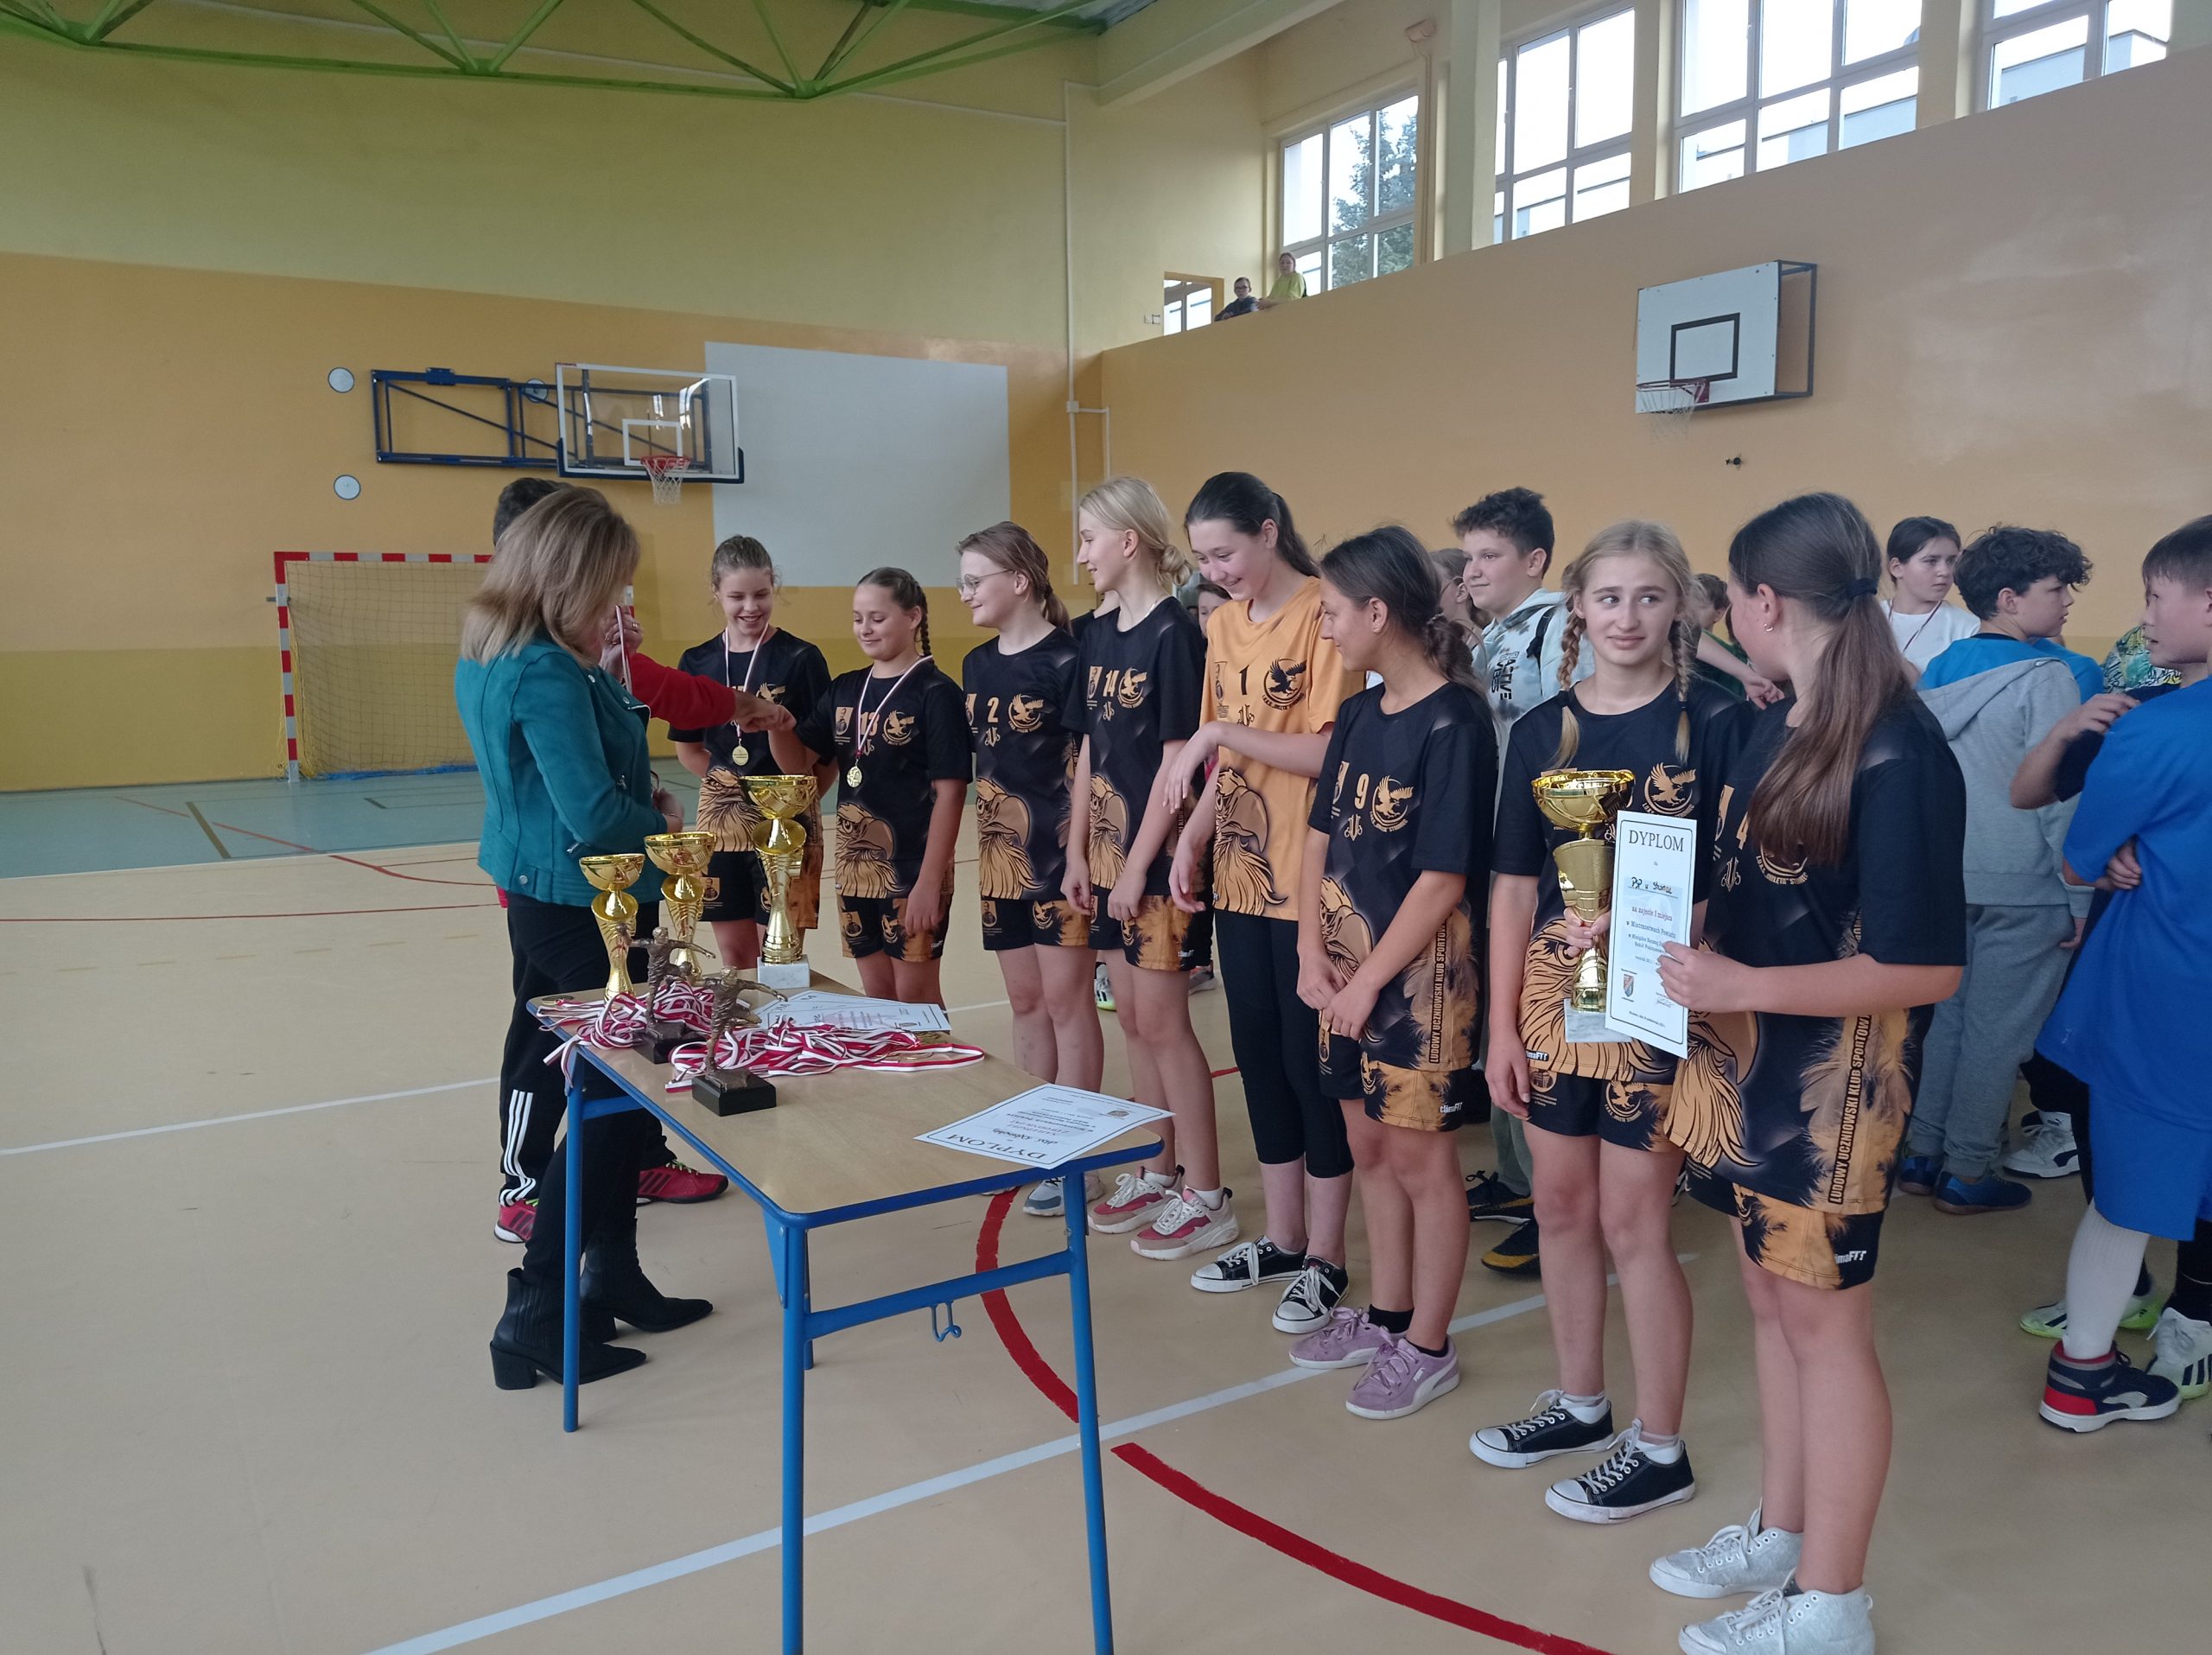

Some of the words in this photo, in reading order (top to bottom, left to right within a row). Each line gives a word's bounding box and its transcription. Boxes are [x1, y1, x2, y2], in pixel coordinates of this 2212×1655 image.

[1103, 670, 1120, 697] 14
[1239, 664, 1250, 696] 1
[861, 711, 880, 736] 13
[987, 697, 1000, 722] 2
[1354, 773, 1370, 809] 9
[1629, 830, 1684, 852] DYPLOM
[1434, 963, 1445, 983] KLUB
[1433, 983, 1444, 1031] UCZNIOWSKI
[1430, 1032, 1441, 1064] LUDOWY
[1847, 1069, 1861, 1098] KLUB
[1838, 1097, 1859, 1160] UCZNIOWSKI
[947, 1134, 1046, 1159] DYPLOM
[1830, 1160, 1848, 1204] LUDOWY
